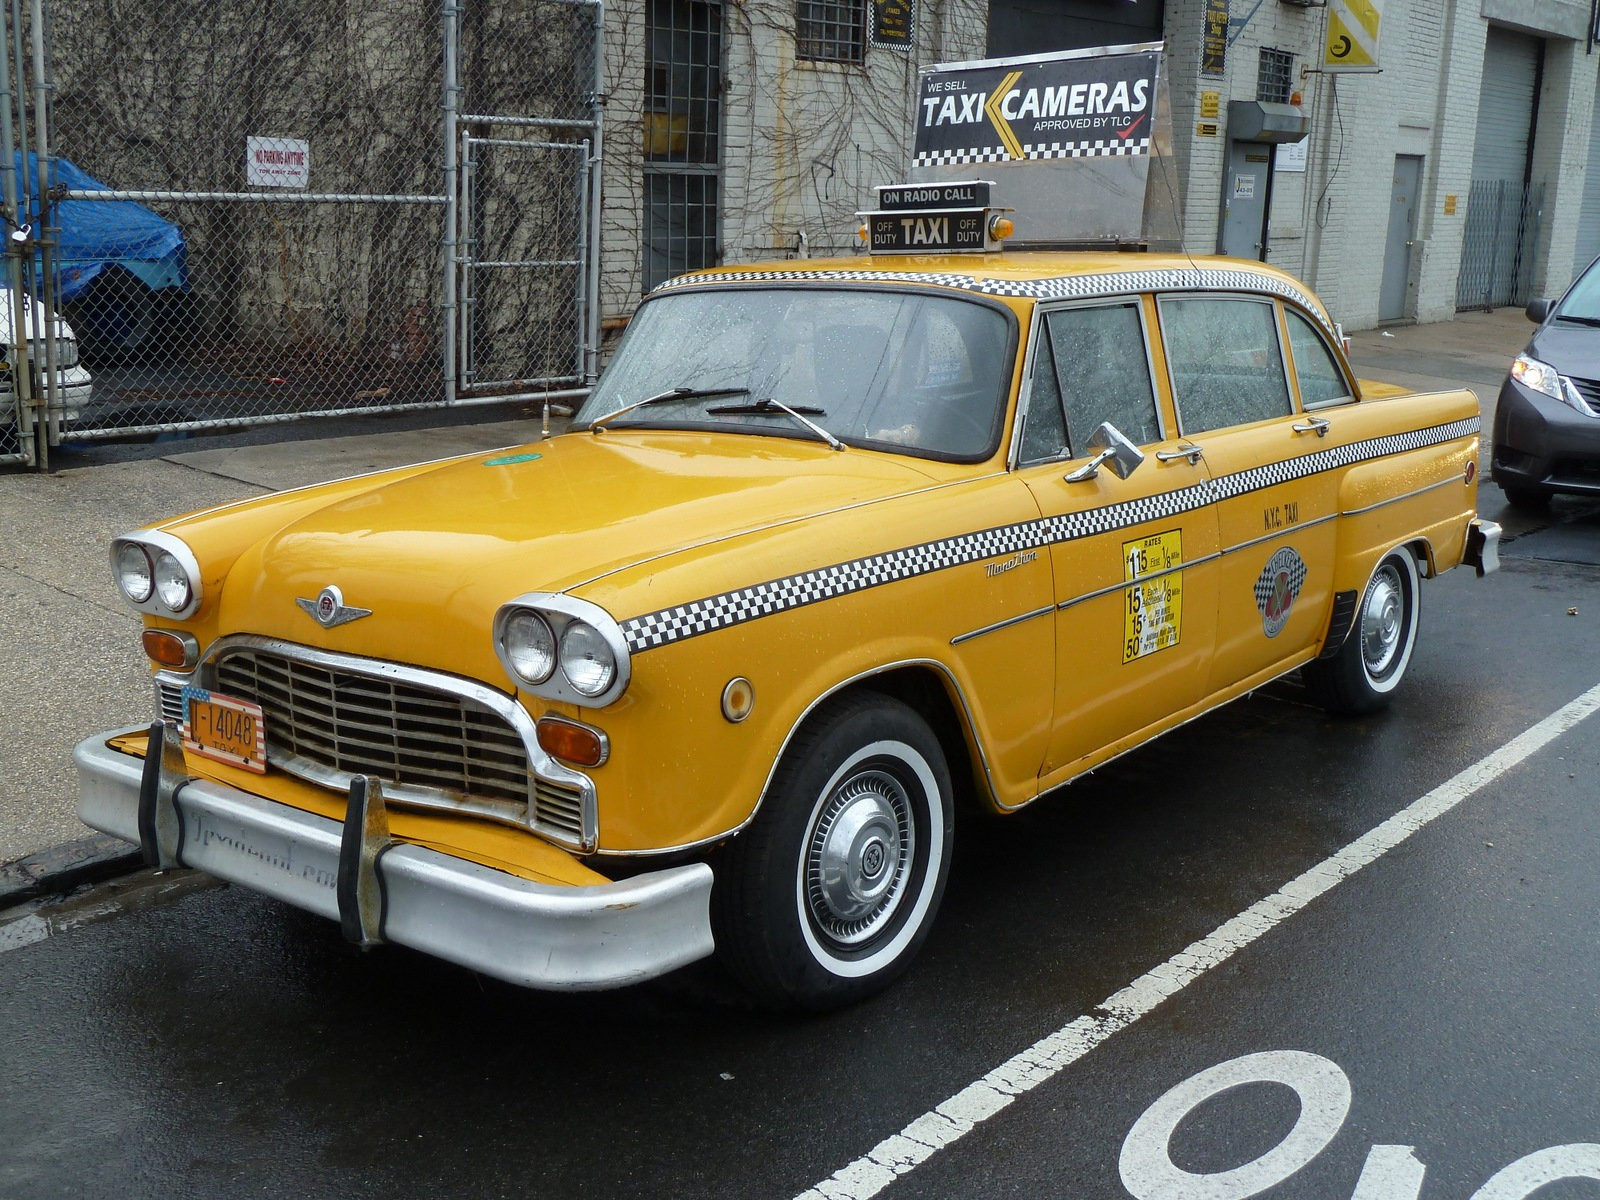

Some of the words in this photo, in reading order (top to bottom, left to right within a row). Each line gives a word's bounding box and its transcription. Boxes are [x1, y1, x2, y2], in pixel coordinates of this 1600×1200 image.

[927, 82, 943, 93] WE
[944, 80, 967, 91] SELL
[923, 92, 987, 127] TAXI
[1000, 78, 1149, 121] CAMERAS
[1033, 117, 1091, 132] APPROVED
[1093, 116, 1108, 128] BY
[1110, 115, 1131, 127] TLC
[256, 149, 263, 163] NO
[264, 149, 284, 165] PARKING
[284, 151, 304, 166] ANYTIME
[883, 191, 900, 204] ON
[903, 189, 940, 203] RADIO
[944, 188, 974, 201] CALL
[876, 221, 893, 232] OFF
[901, 217, 949, 245] TAXI
[959, 218, 977, 230] OFF
[874, 233, 897, 245] DUTY
[956, 231, 980, 243] DUTY
[1264, 506, 1282, 531] N.Y.C.
[1284, 501, 1299, 525] TAXI
[1144, 536, 1162, 549] RATES
[984, 551, 1037, 577] Marathon
